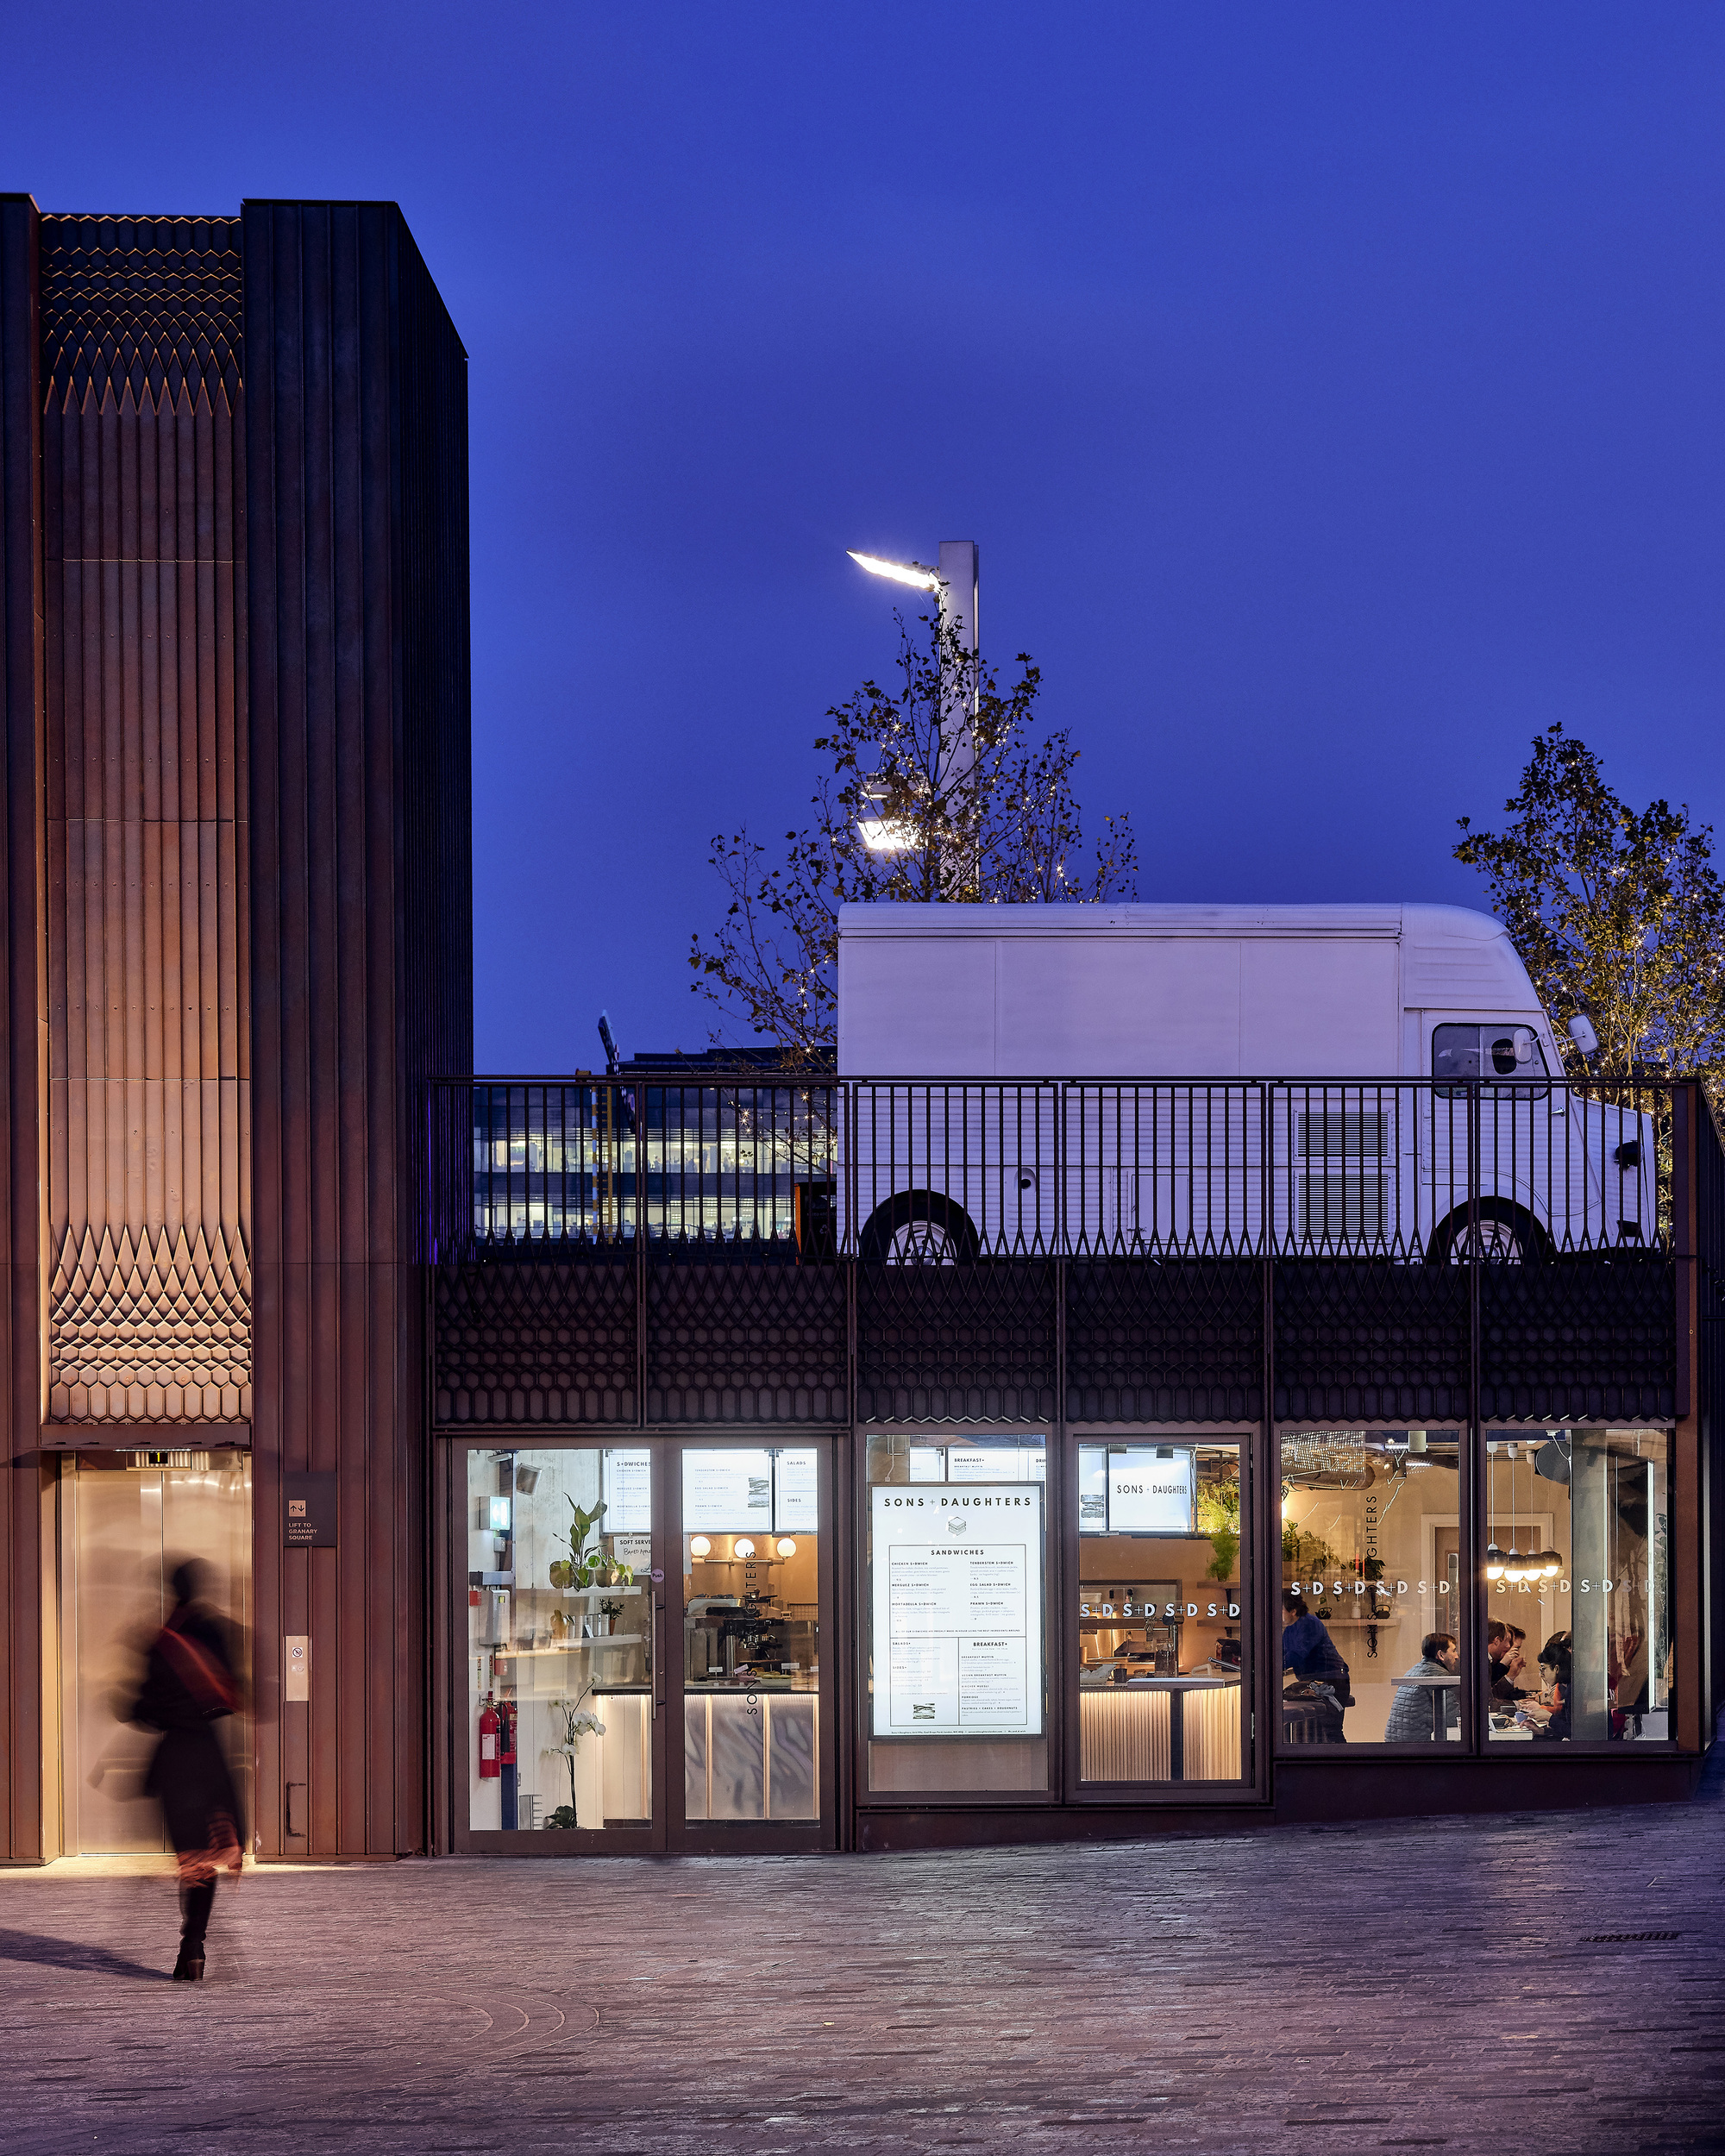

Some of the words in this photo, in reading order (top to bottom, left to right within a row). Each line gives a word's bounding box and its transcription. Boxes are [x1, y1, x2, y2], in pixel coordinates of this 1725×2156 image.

[1116, 1484, 1144, 1494] SONS
[1152, 1484, 1188, 1495] DAUGHTERS
[884, 1498, 925, 1507] SONS
[941, 1497, 1031, 1507] DAUGHTERS
[1290, 1580, 1325, 1595] S+D
[1333, 1580, 1366, 1595] S+D
[1417, 1580, 1451, 1595] S+D
[1496, 1579, 1528, 1594] S+D
[1538, 1579, 1571, 1594] S+D
[1580, 1579, 1614, 1594] S+D
[1080, 1602, 1113, 1617] S+D
[1122, 1602, 1156, 1617] S+D
[1164, 1602, 1198, 1617] S+D
[1207, 1602, 1240, 1617] S+D
[745, 1670, 758, 1715] SONS
